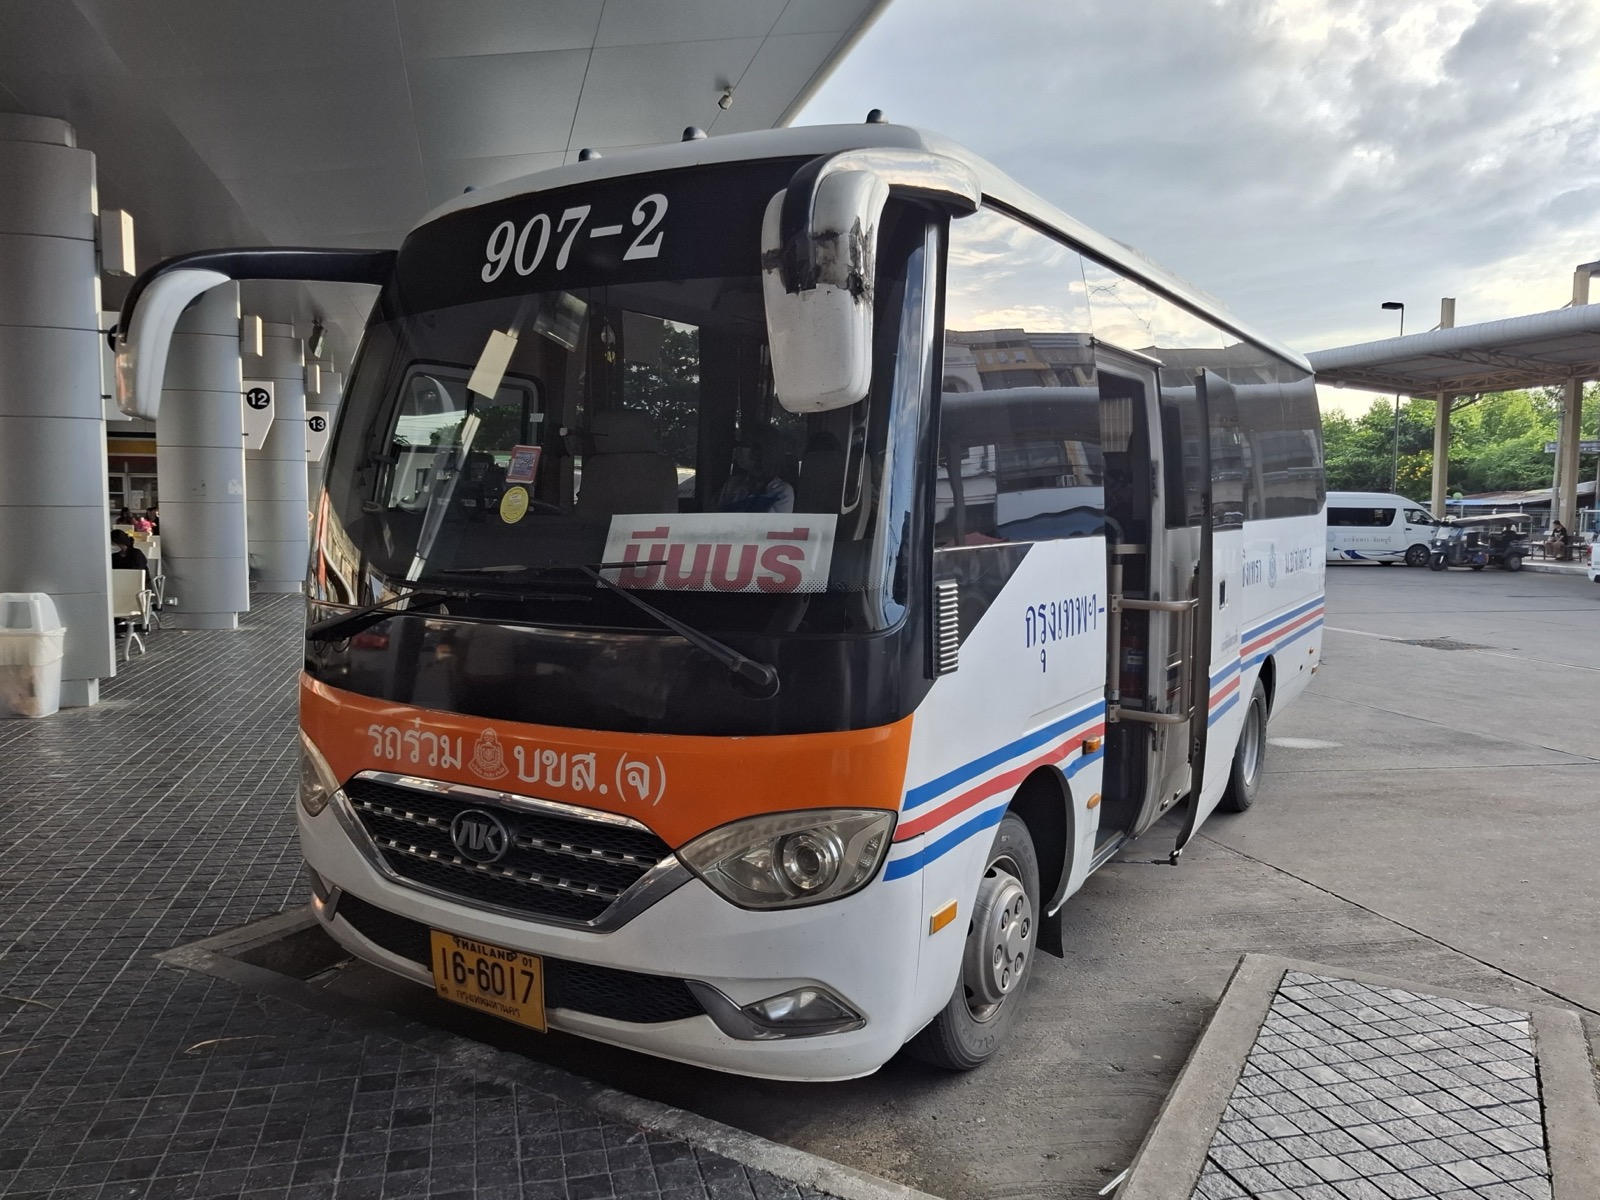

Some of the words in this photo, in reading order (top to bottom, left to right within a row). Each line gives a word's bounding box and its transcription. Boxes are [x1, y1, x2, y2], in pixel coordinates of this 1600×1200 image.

[481, 193, 669, 283] 907-2
[248, 392, 268, 406] 12
[310, 418, 325, 430] 13
[1025, 593, 1105, 673] กรุงเทพฯ-
[367, 717, 463, 771] รถร่วม
[441, 947, 535, 1005] 16-6017
[454, 936, 517, 963] THAILAND
[522, 958, 533, 969] 01
